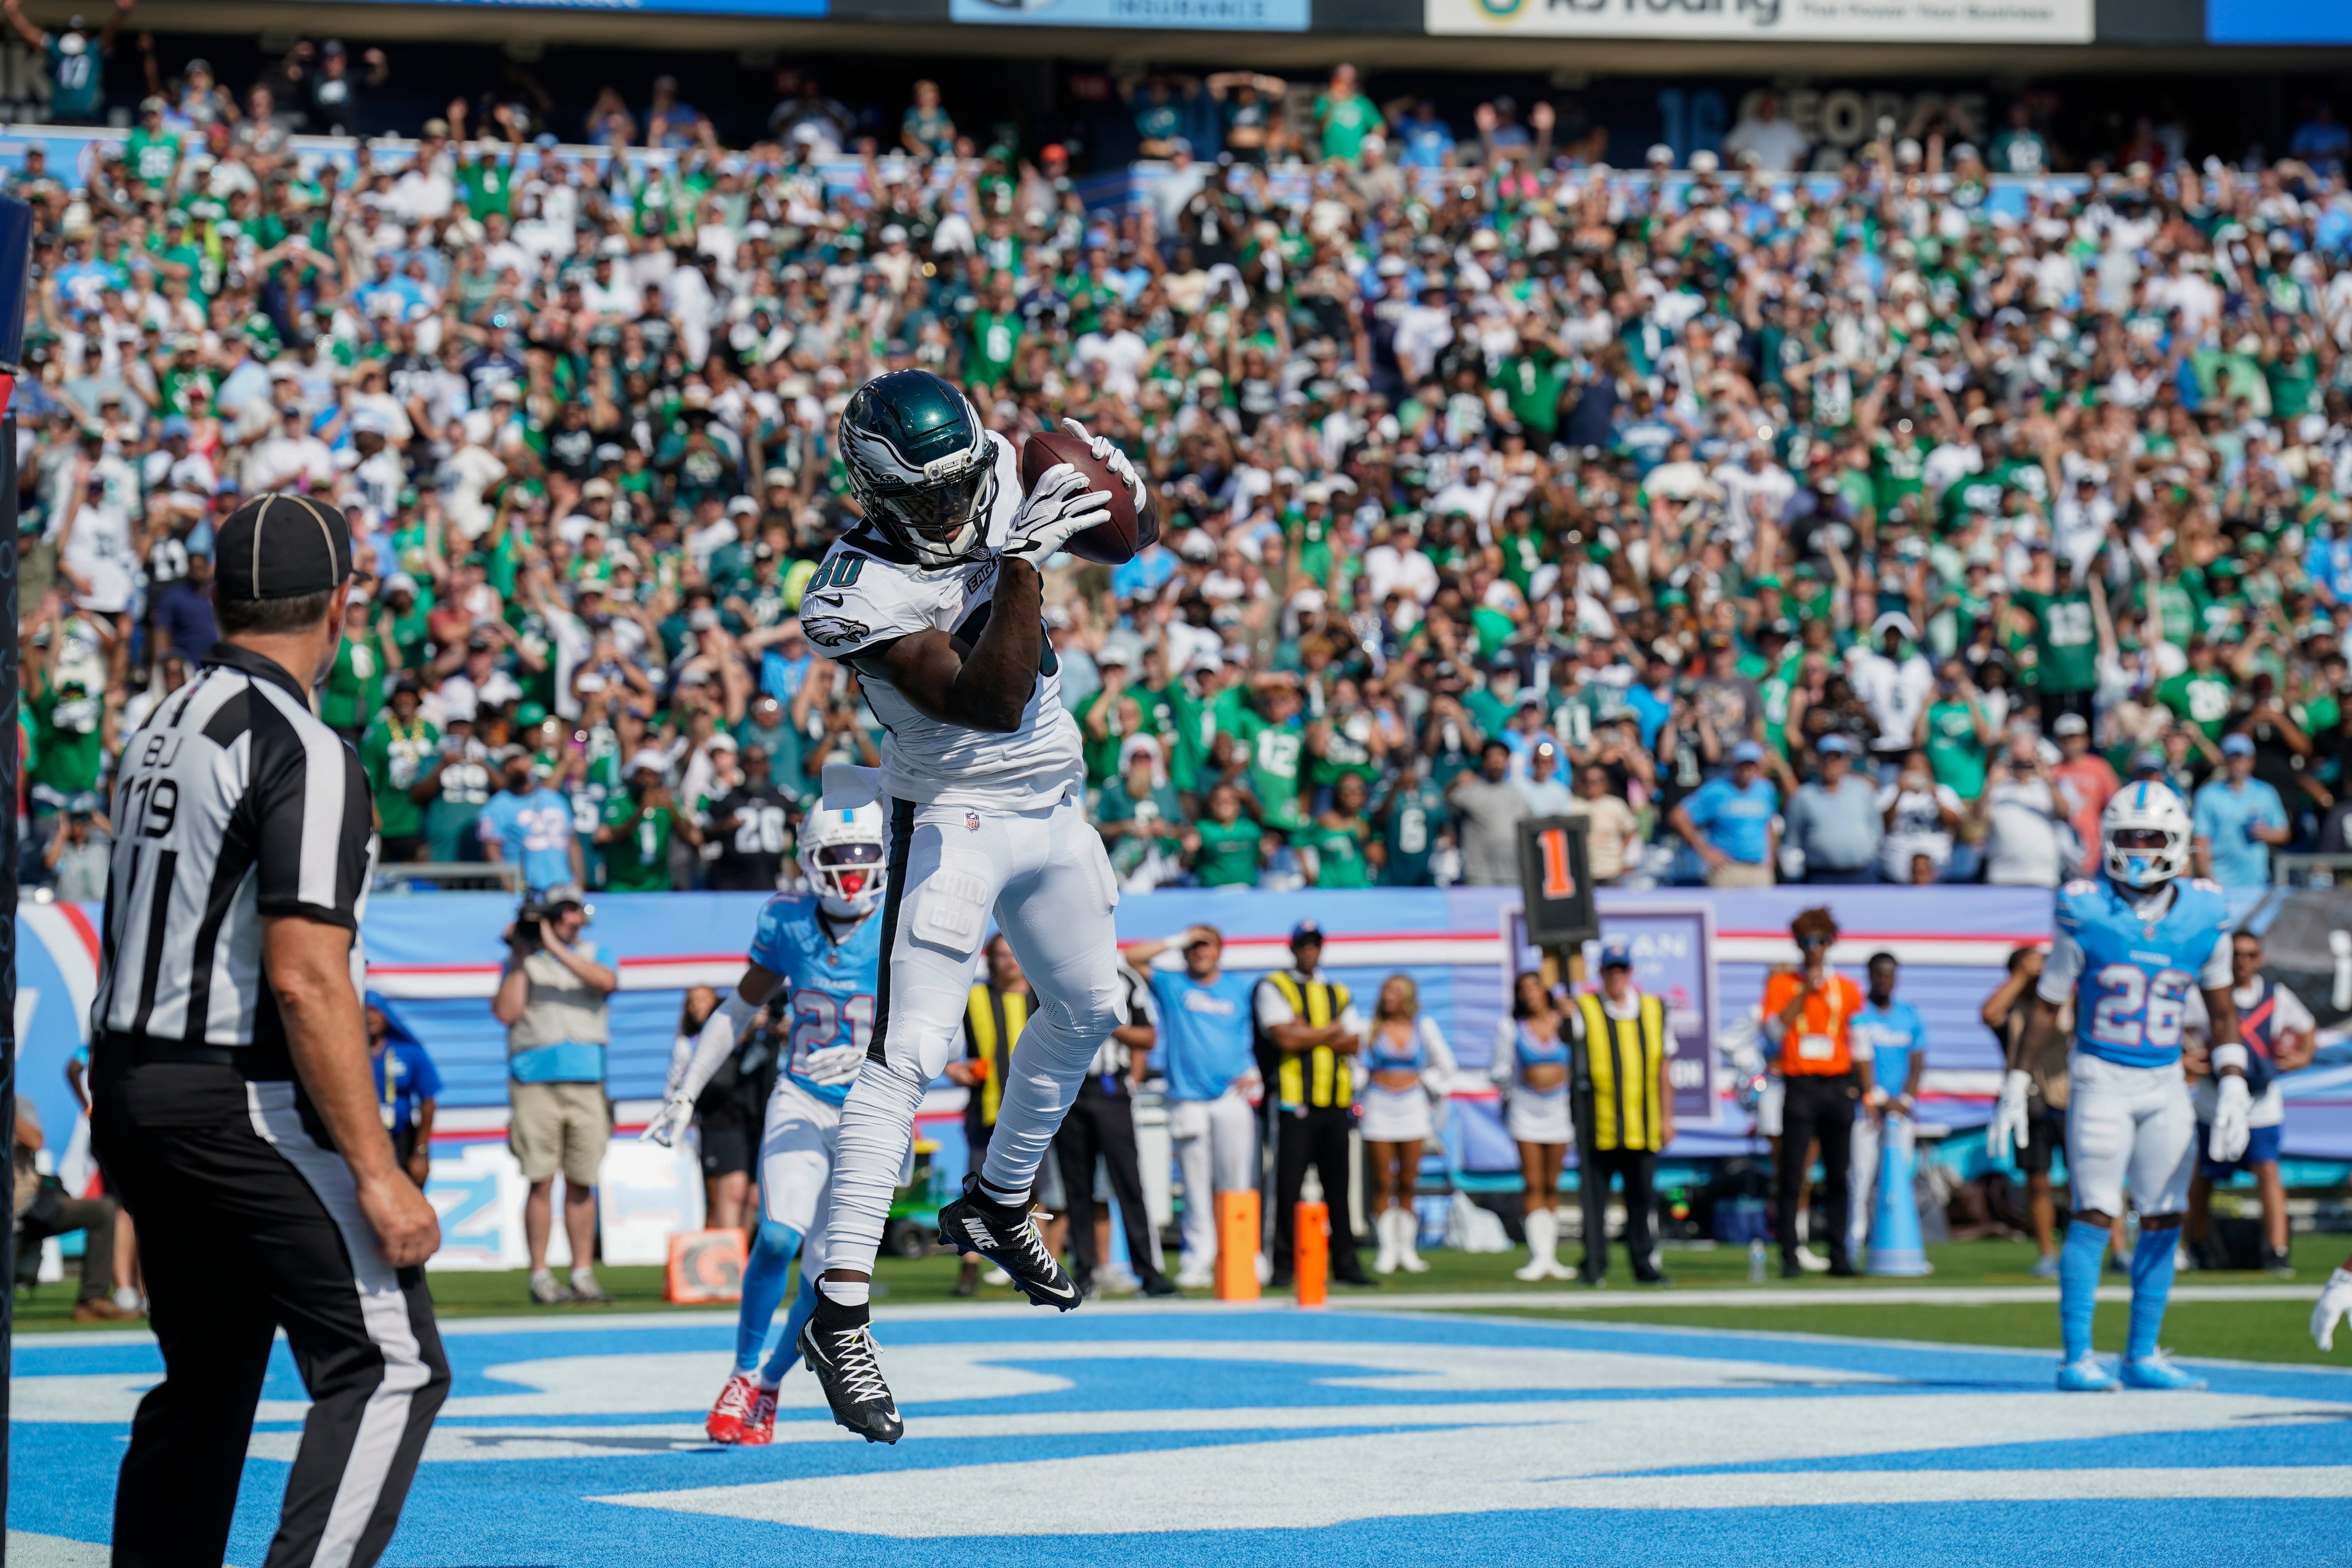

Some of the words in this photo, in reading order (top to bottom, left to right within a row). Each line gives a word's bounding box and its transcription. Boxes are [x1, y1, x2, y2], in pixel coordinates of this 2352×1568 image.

[942, 460, 960, 470] EAGLES
[806, 552, 868, 593] 80
[966, 551, 1002, 593] EAGLE
[142, 735, 182, 768] BJ
[120, 775, 178, 839] 119
[966, 819, 978, 828] NFL
[1537, 828, 1576, 900] 1
[2092, 963, 2194, 1047] 26
[789, 988, 876, 1076] 21
[961, 1217, 999, 1250] NIKE
[683, 1238, 740, 1296] G
